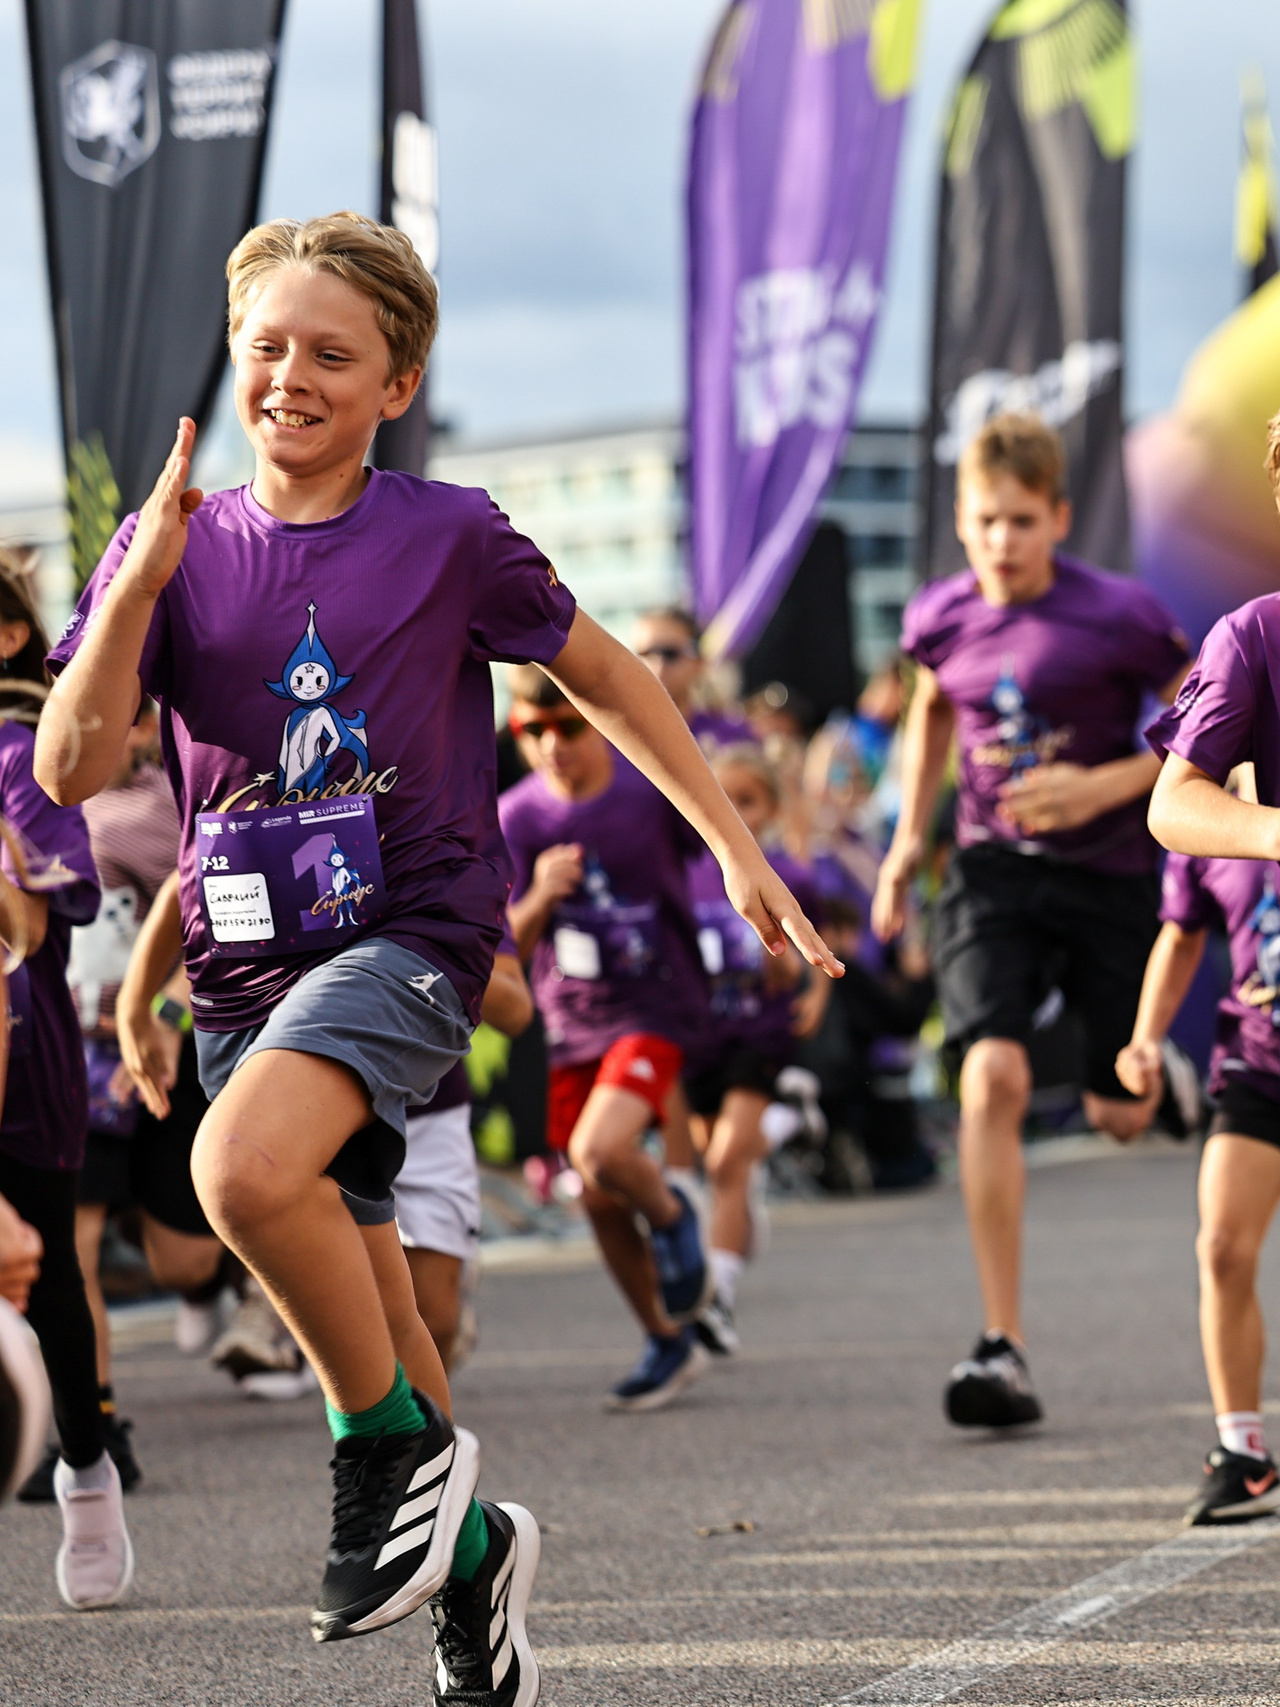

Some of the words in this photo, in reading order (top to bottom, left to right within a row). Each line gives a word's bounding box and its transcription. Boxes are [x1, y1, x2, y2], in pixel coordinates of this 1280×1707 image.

[316, 802, 365, 816] SUPREME
[201, 855, 230, 871] 7-12
[311, 883, 375, 917] Сириус
